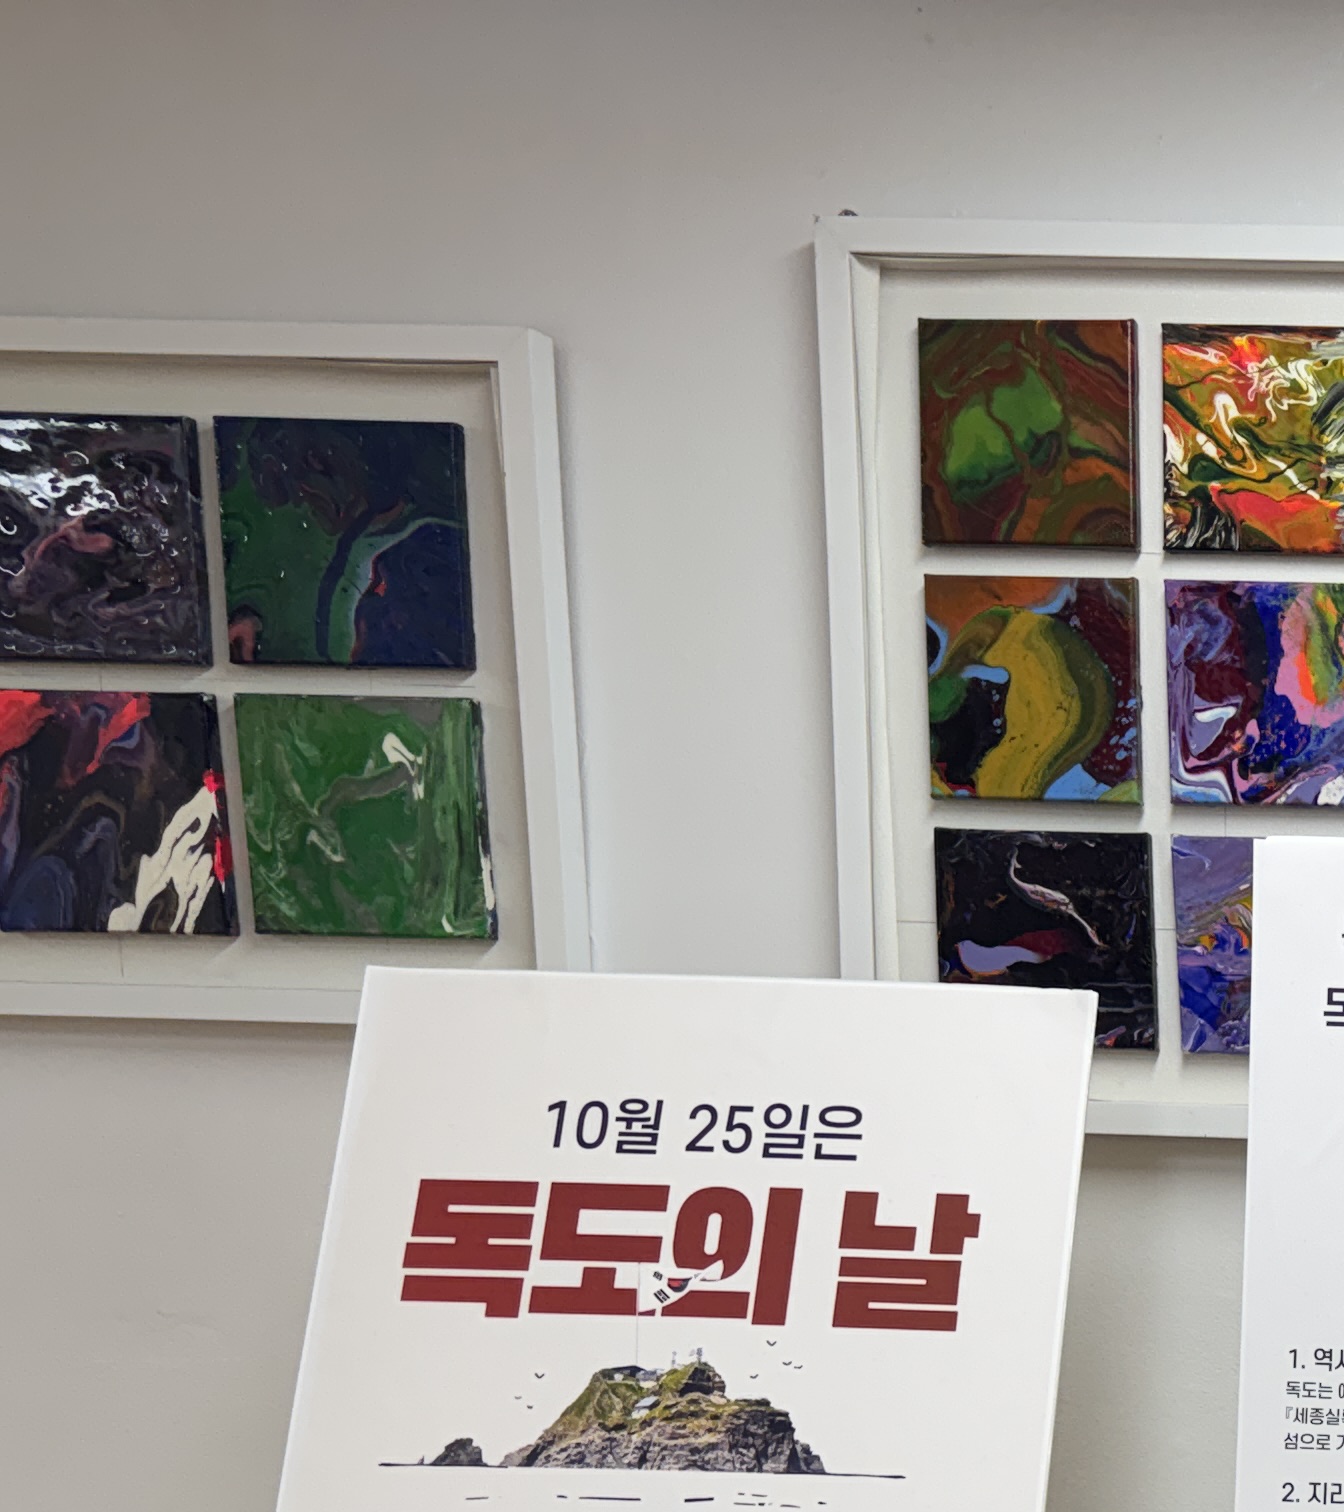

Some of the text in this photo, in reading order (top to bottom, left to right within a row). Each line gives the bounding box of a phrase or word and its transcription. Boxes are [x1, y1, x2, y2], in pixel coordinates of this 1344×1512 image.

[547, 1097, 863, 1163] 10월 25일은
[400, 1177, 981, 1333] 독도의 날
[1288, 1348, 1306, 1370] 1.
[1285, 1380, 1334, 1401] 독도는
[1283, 1431, 1331, 1452] 섬으로
[1281, 1482, 1300, 1504] 2.
